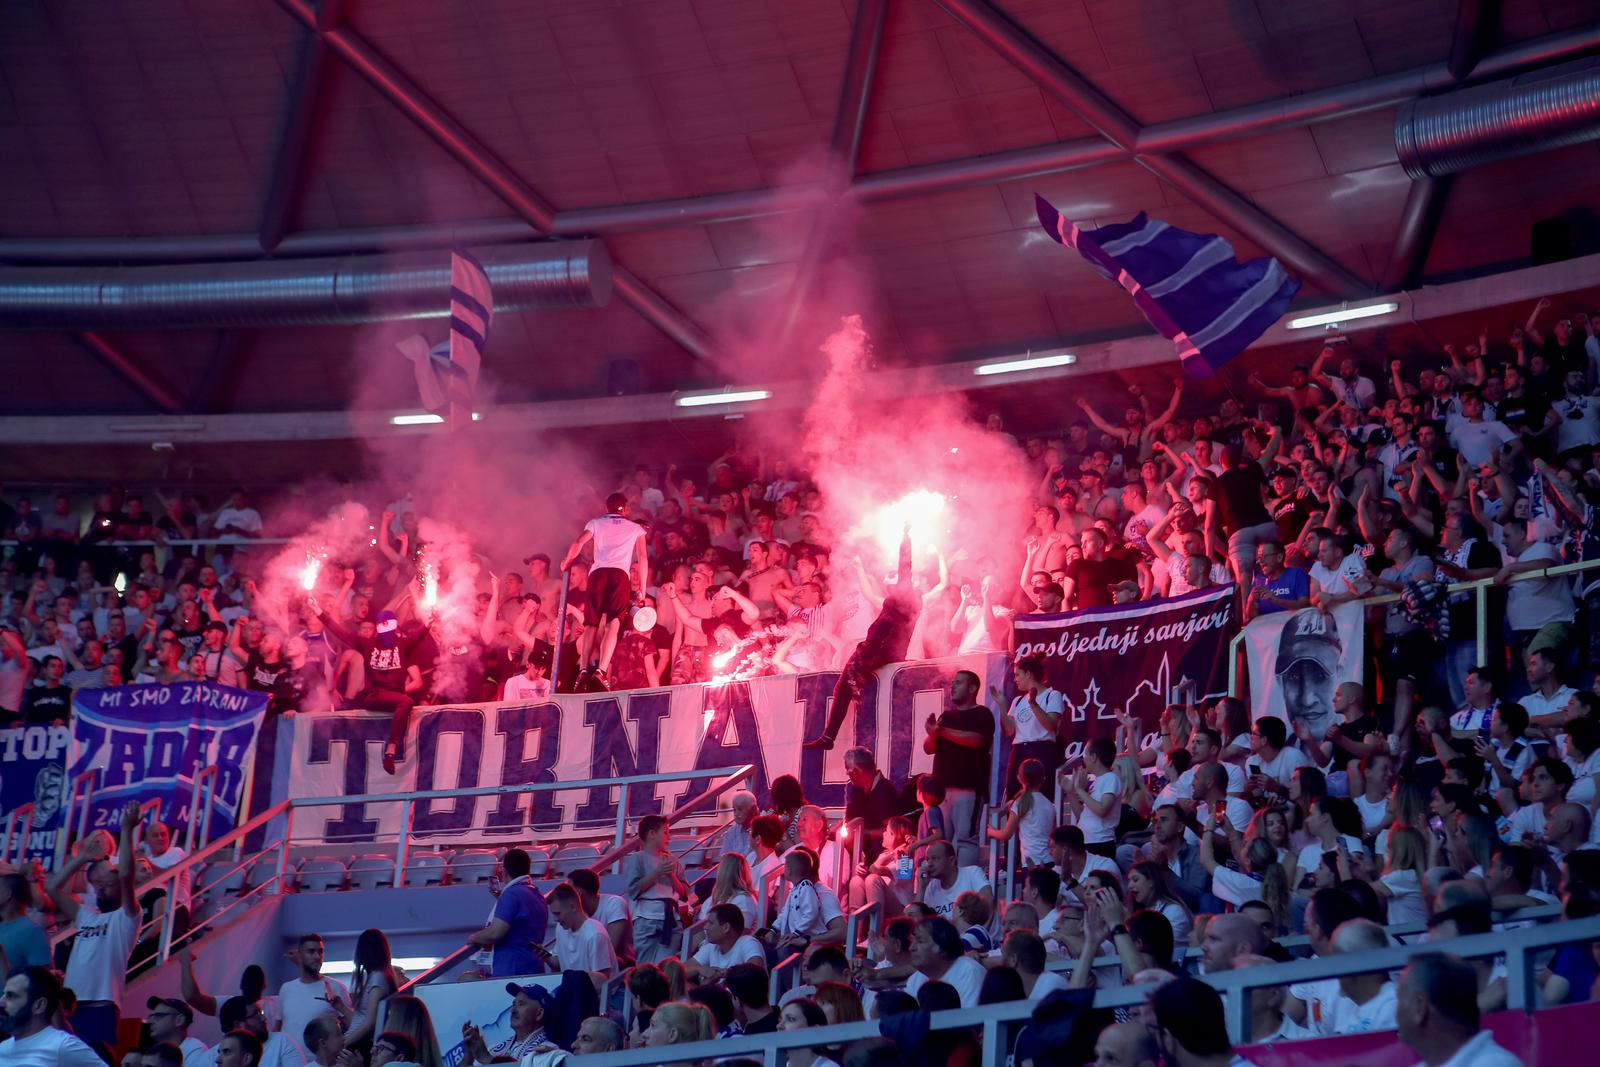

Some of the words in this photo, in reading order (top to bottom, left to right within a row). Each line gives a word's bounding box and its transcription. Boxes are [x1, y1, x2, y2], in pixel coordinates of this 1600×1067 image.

[1143, 602, 1231, 643] sanjari
[99, 690, 122, 707] MI
[129, 687, 171, 707] SMO
[180, 685, 249, 712] ZADRANI
[0, 726, 70, 762] TOP
